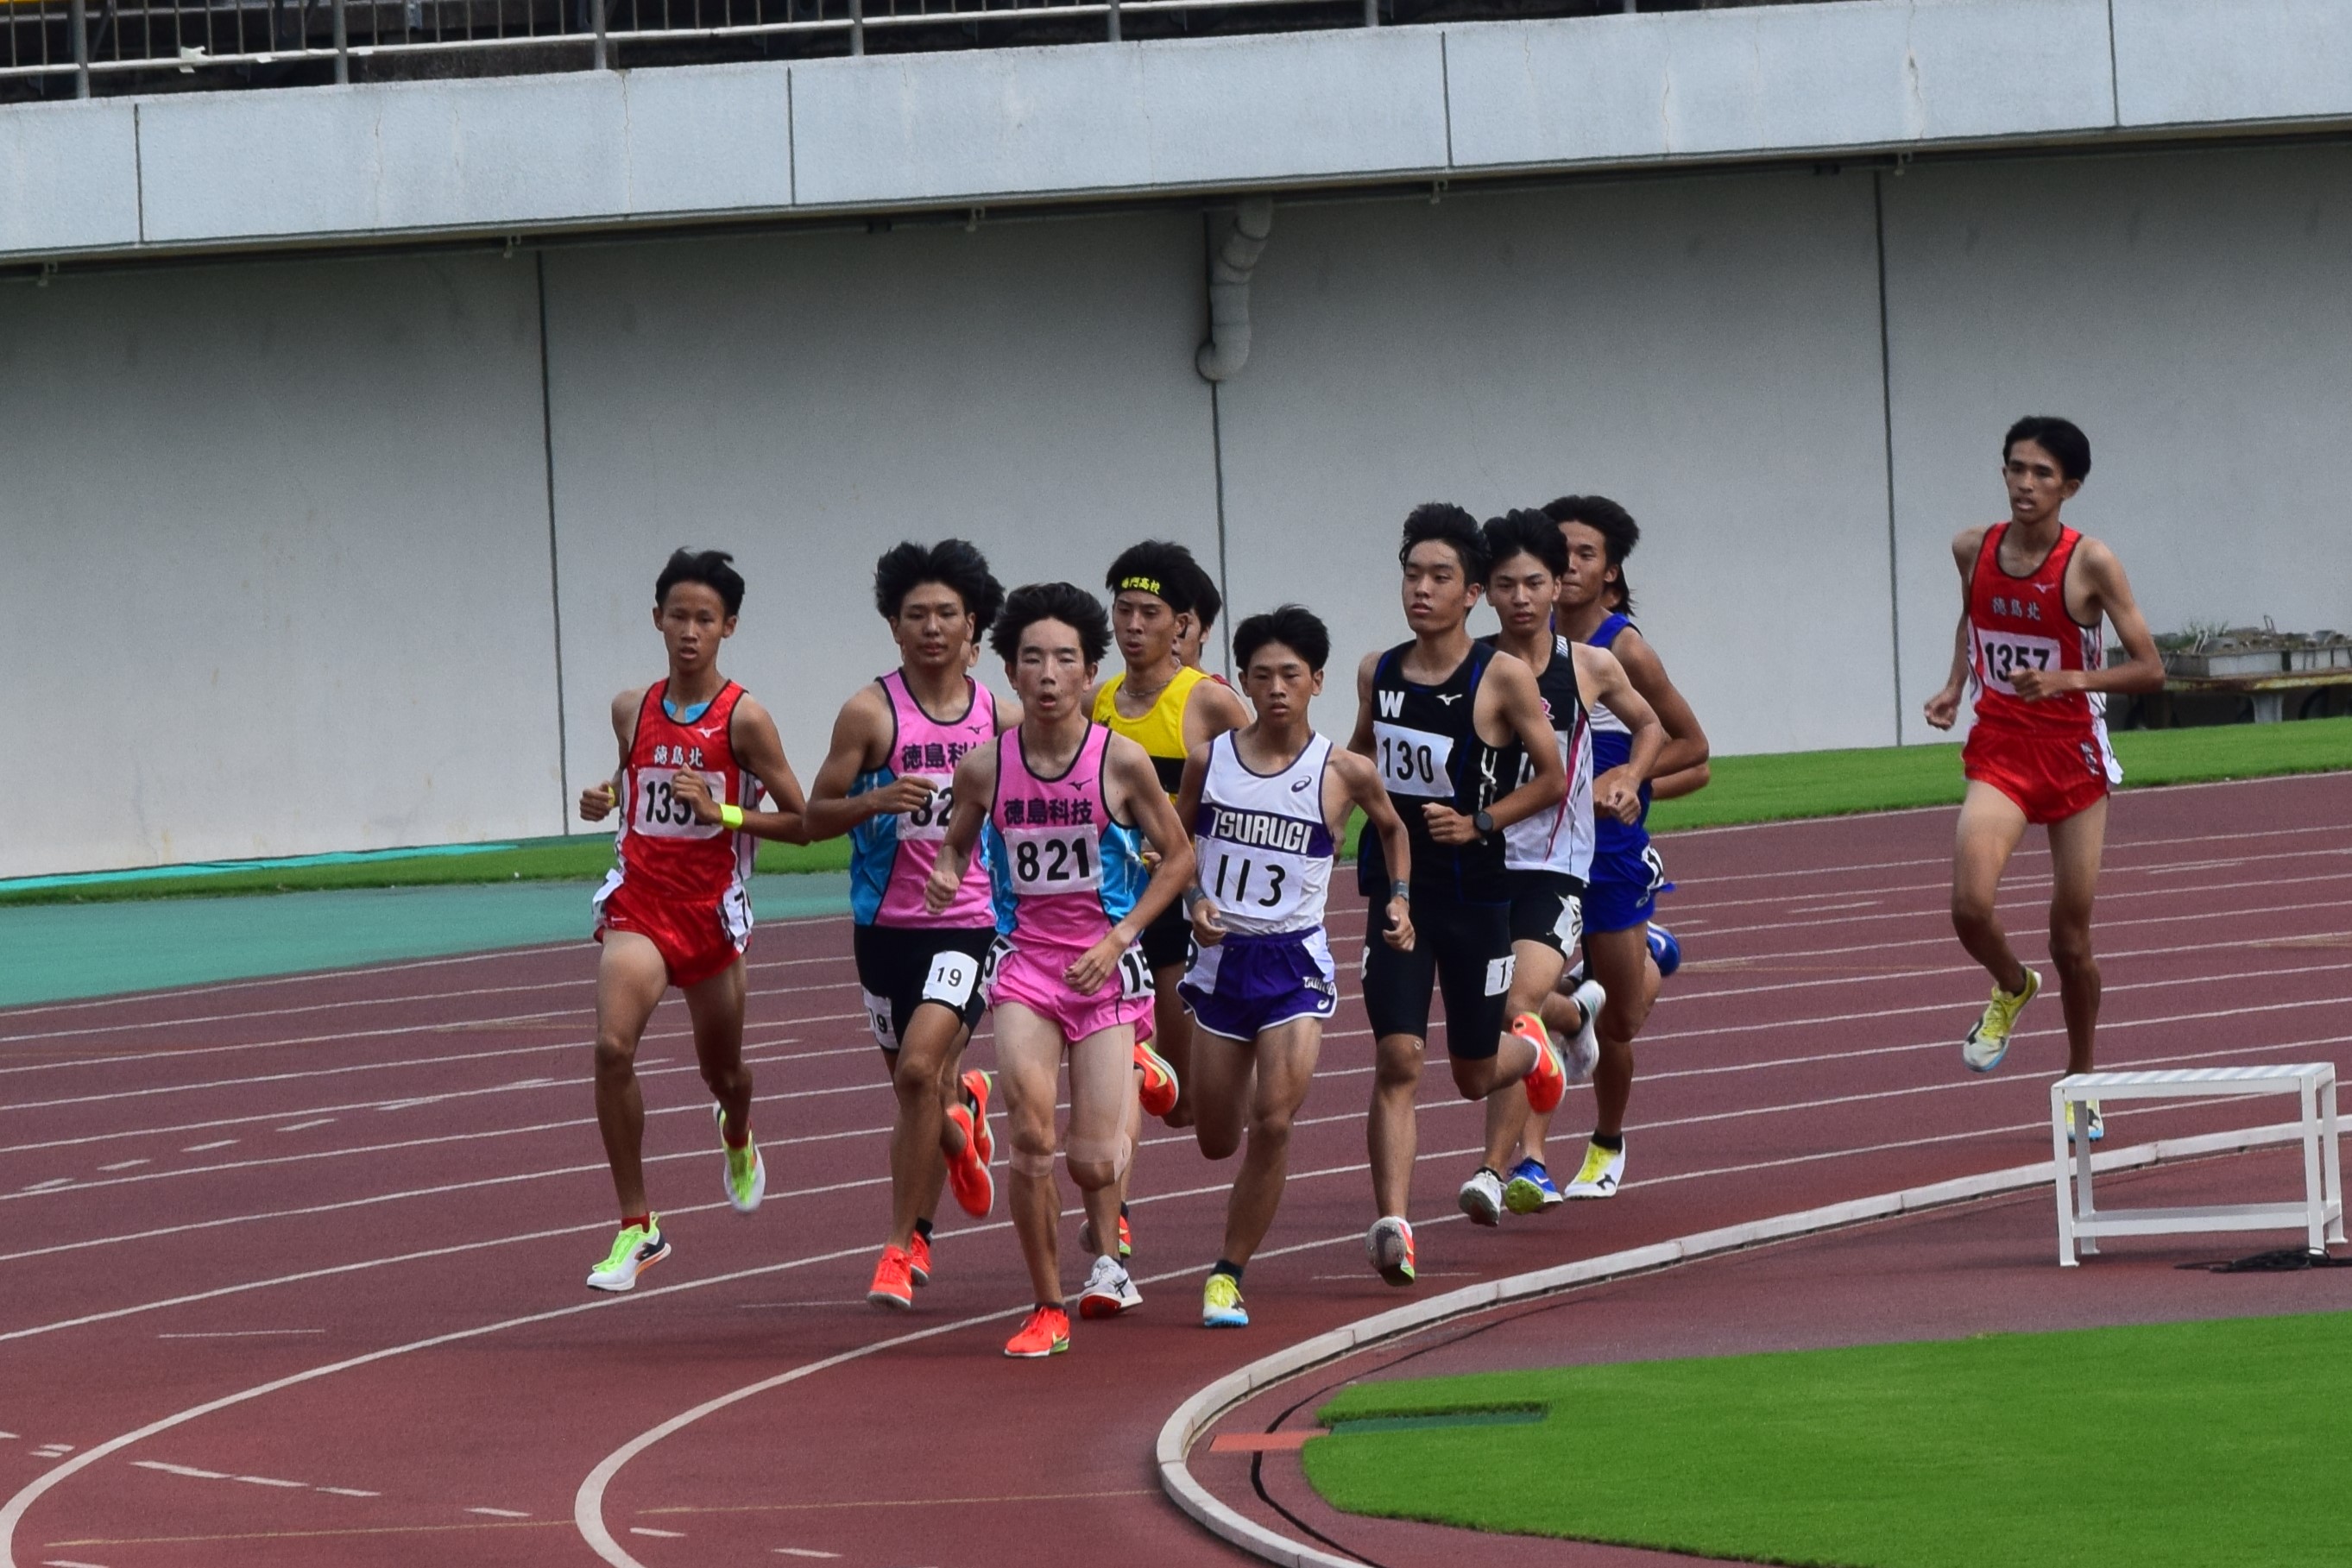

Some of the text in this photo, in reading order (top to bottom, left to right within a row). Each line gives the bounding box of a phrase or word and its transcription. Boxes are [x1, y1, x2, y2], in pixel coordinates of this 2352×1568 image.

[1378, 690, 1405, 718] W
[901, 741, 978, 771] 徳島科
[1382, 737, 1435, 784] 130
[1004, 797, 1093, 825] 徳島科技
[1211, 807, 1312, 853] TSURUGI
[1017, 837, 1090, 882] 821
[1215, 853, 1286, 907] 113
[936, 967, 962, 987] 19
